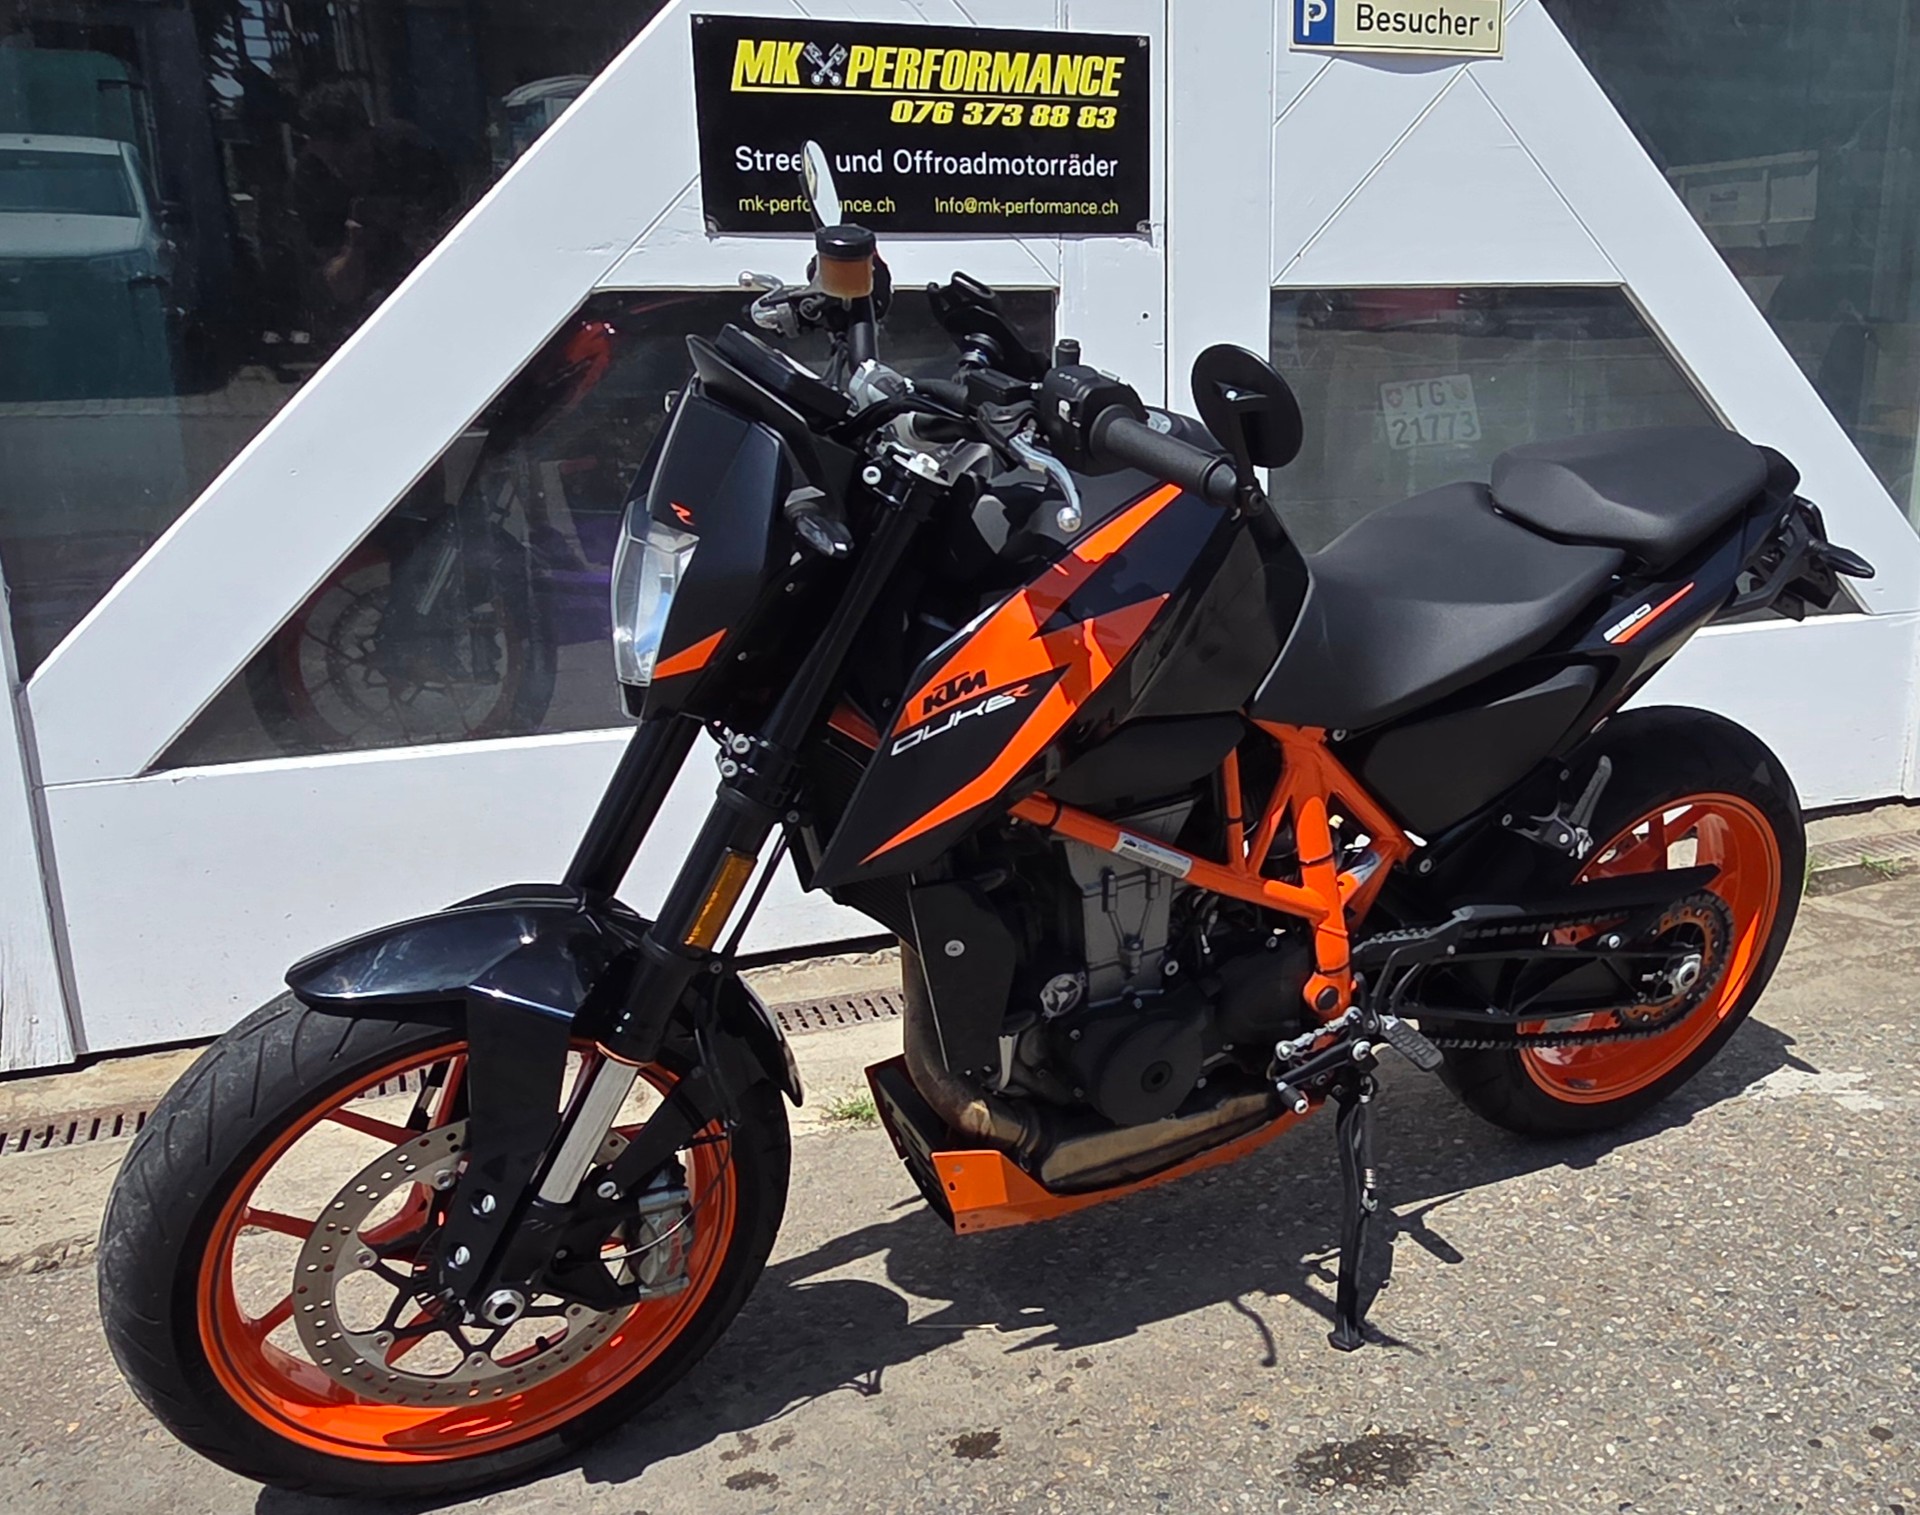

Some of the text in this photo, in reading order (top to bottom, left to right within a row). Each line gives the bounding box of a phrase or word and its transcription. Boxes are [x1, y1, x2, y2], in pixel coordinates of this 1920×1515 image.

[1303, 0, 1480, 37] P Besucher
[731, 40, 1125, 97] MK PERFORMANCE
[890, 100, 1117, 129] 076 373 88 83
[735, 145, 1118, 177] Stree und Offroadmotorräder
[739, 195, 1118, 217] mk-perfonce.ch Info@mk-performance.ch
[1406, 381, 1446, 409] TG
[1391, 411, 1477, 446] 21773
[922, 669, 988, 716] KTM
[890, 694, 1016, 756] DUKE
